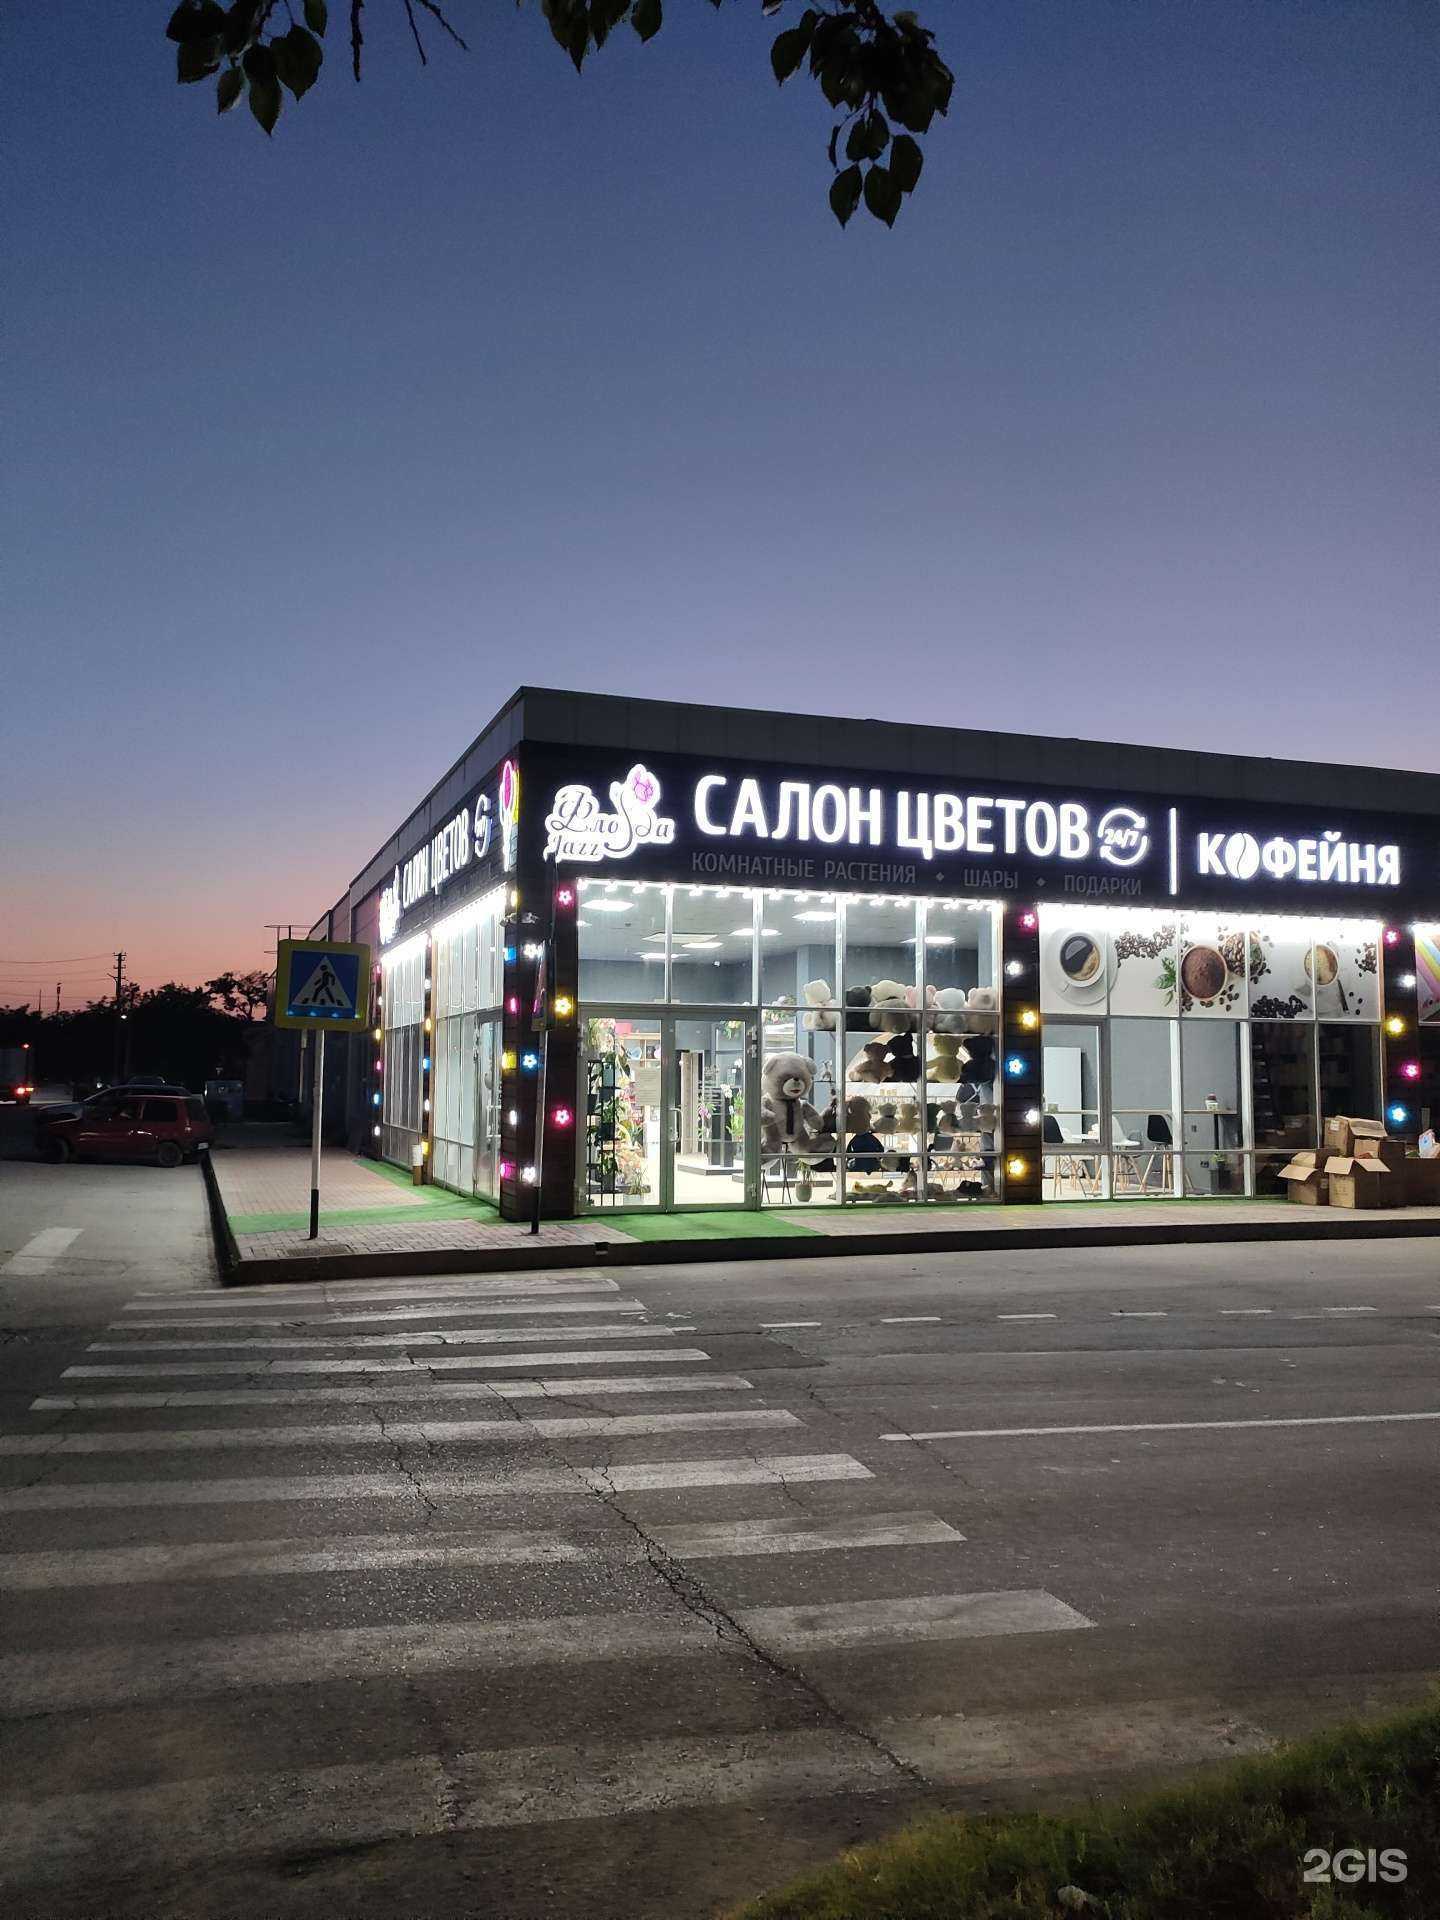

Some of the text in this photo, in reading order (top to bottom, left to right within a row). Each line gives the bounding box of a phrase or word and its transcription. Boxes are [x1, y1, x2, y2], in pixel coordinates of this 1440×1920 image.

[694, 775, 1090, 860] САЛОН ЦВЕТОВ
[1104, 828, 1140, 849] 24/7
[431, 808, 470, 895] ЦВЕТОВ
[691, 852, 1143, 897] КОМНАТНЫЕ РАСТЕНИЯ ШАРЫ ПОДАРКИ
[1198, 830, 1402, 886] КОФЕЙНЯ
